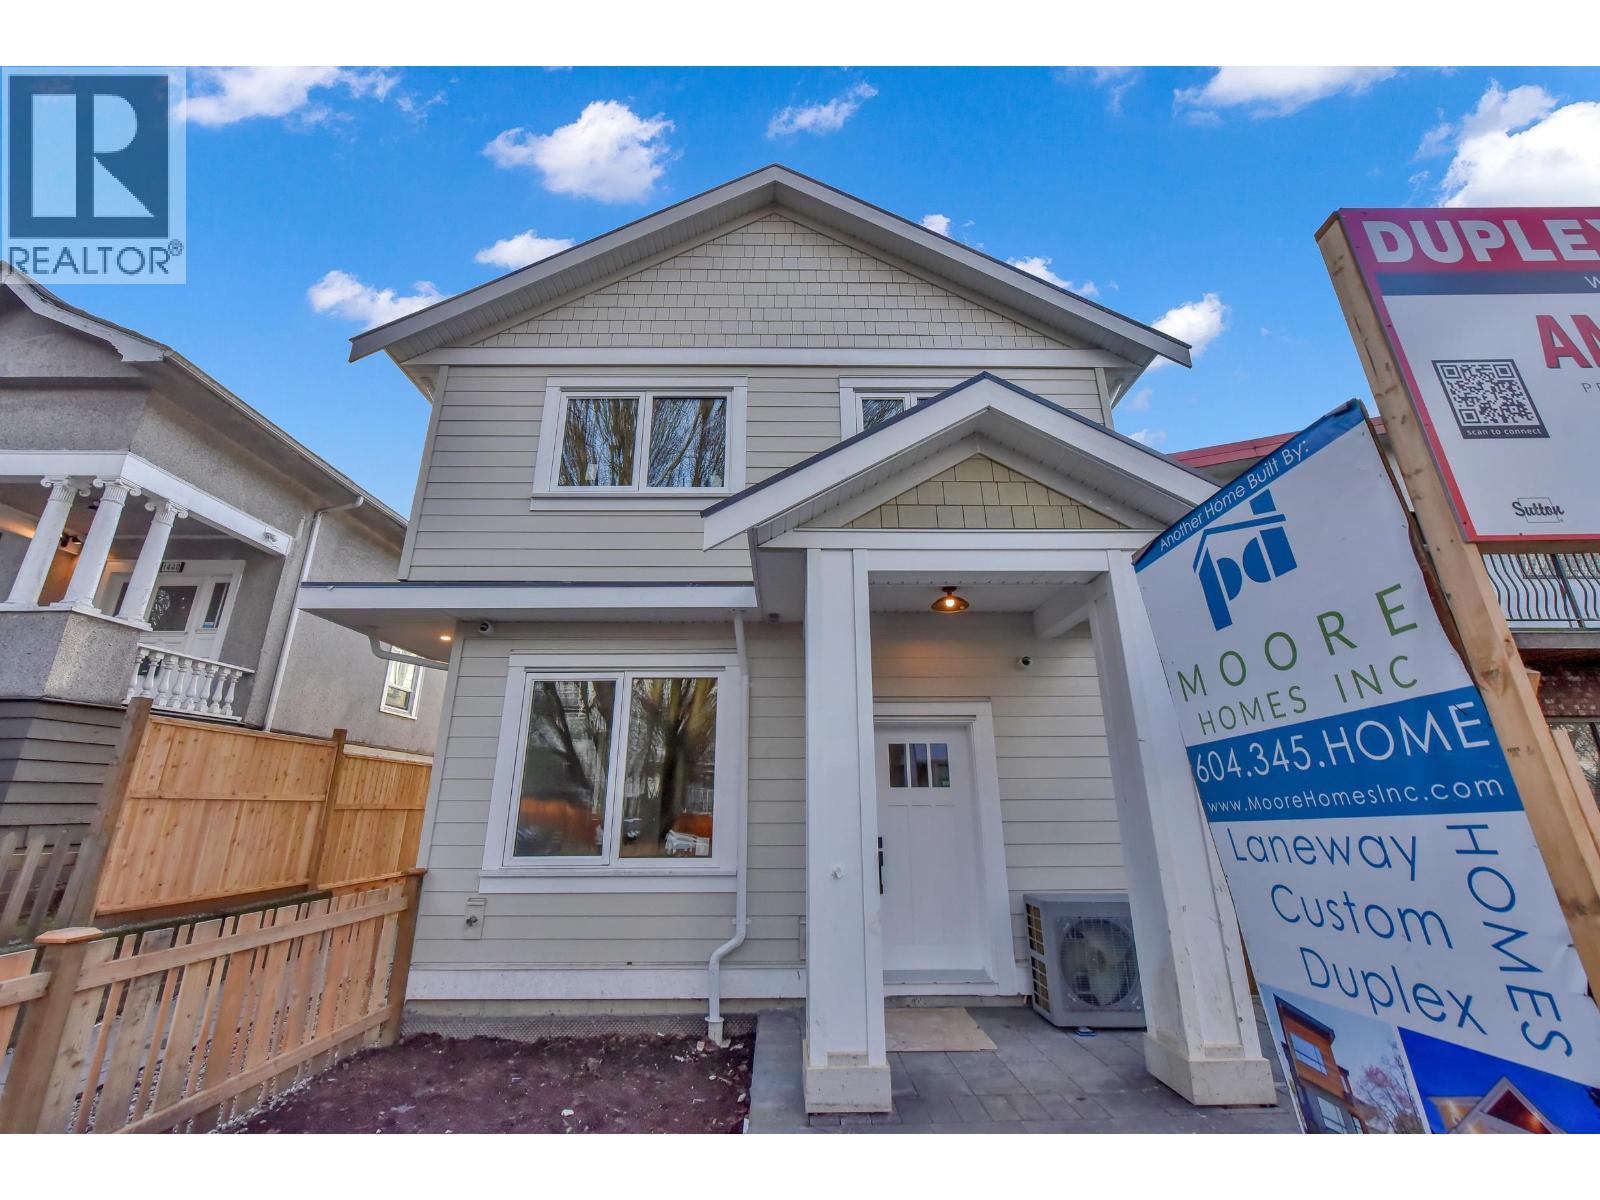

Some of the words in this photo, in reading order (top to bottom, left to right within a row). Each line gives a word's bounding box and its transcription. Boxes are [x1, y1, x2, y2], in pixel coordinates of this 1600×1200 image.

[1160, 512, 1204, 552] Another
[1204, 486, 1246, 520] Home
[1247, 460, 1280, 490] Built
[1282, 440, 1310, 465] By:
[1511, 501, 1565, 517] Sutton
[1177, 583, 1418, 702] MOORE
[1198, 685, 1307, 736] HOMES
[1334, 655, 1418, 703] INC
[1196, 701, 1490, 783] 604.345.HOME
[1207, 778, 1505, 813] www.MooreHomesInc.com
[1227, 828, 1417, 881] Laneway
[1270, 884, 1453, 949] Custom
[1446, 823, 1573, 1057] HOMES
[1299, 946, 1488, 1035] Duplex
